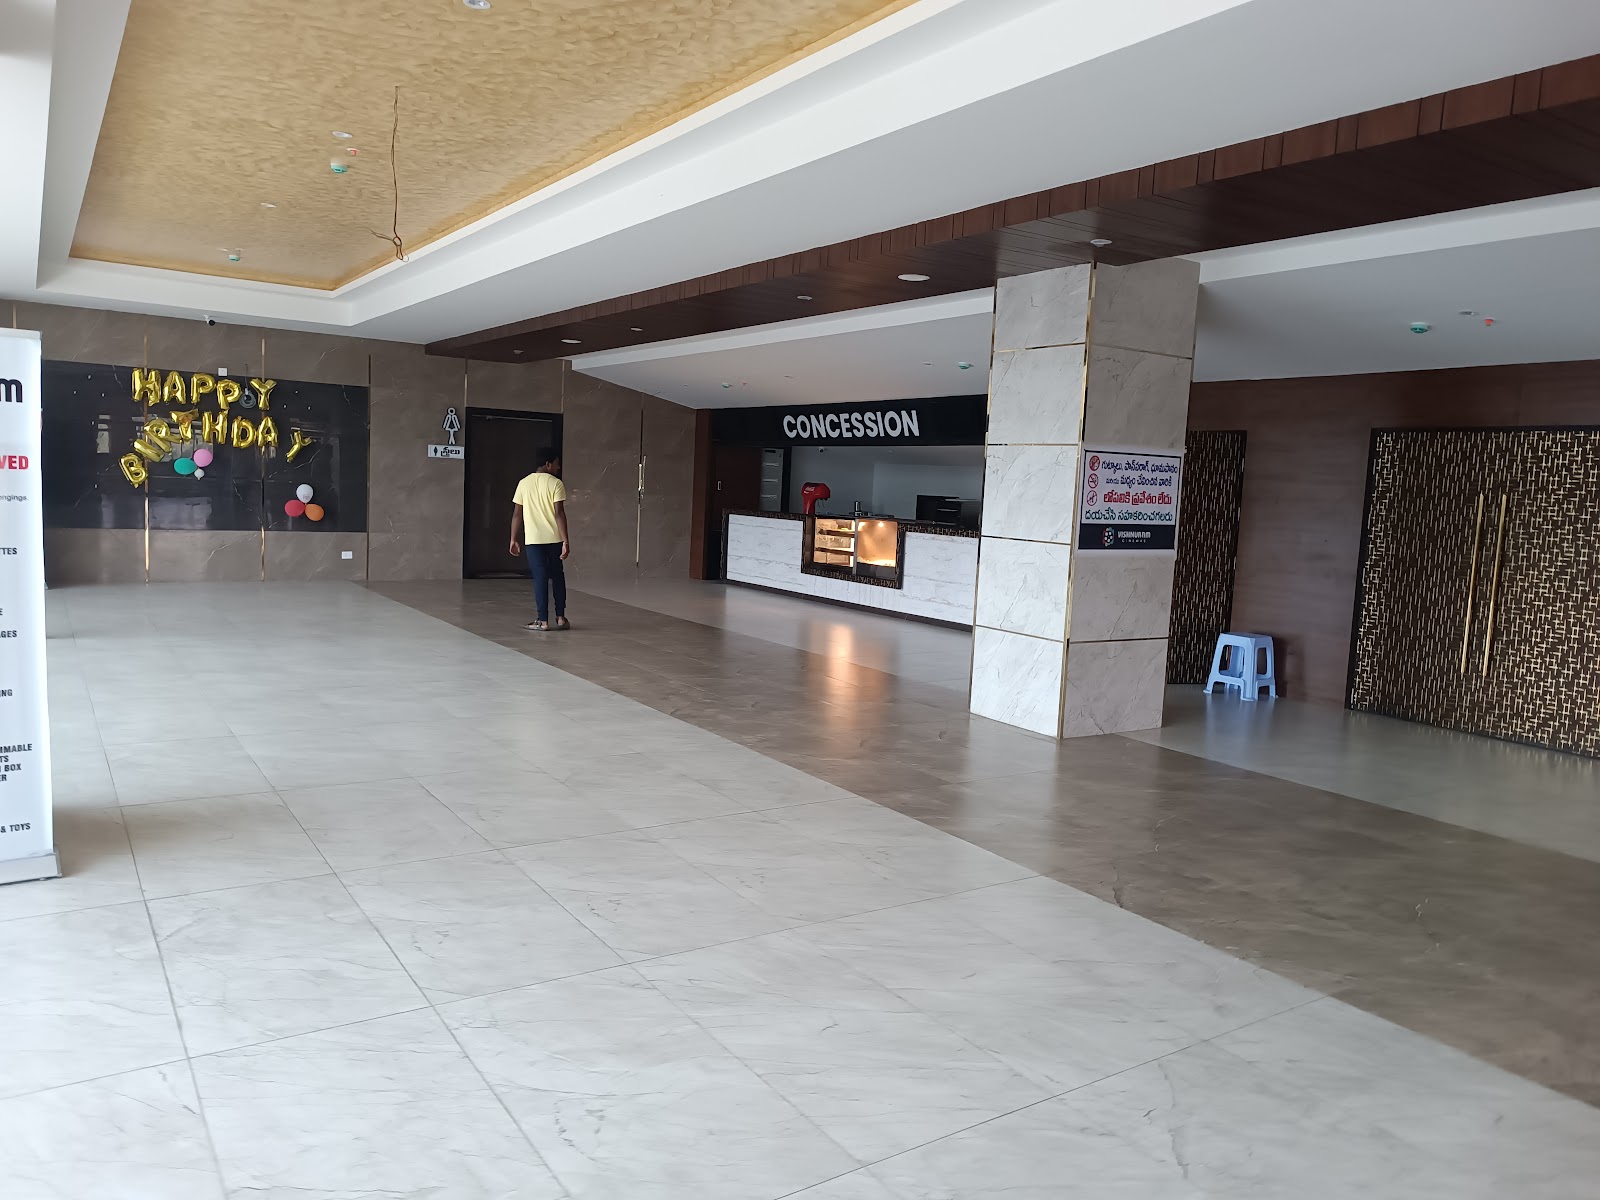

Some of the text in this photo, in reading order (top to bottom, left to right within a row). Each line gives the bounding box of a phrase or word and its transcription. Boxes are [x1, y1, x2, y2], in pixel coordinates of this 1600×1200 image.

[131, 367, 278, 411] HAPPY
[783, 410, 920, 439] CONCESSION
[118, 408, 313, 489] BIRTHDAY
[9, 822, 31, 832] TOYS
